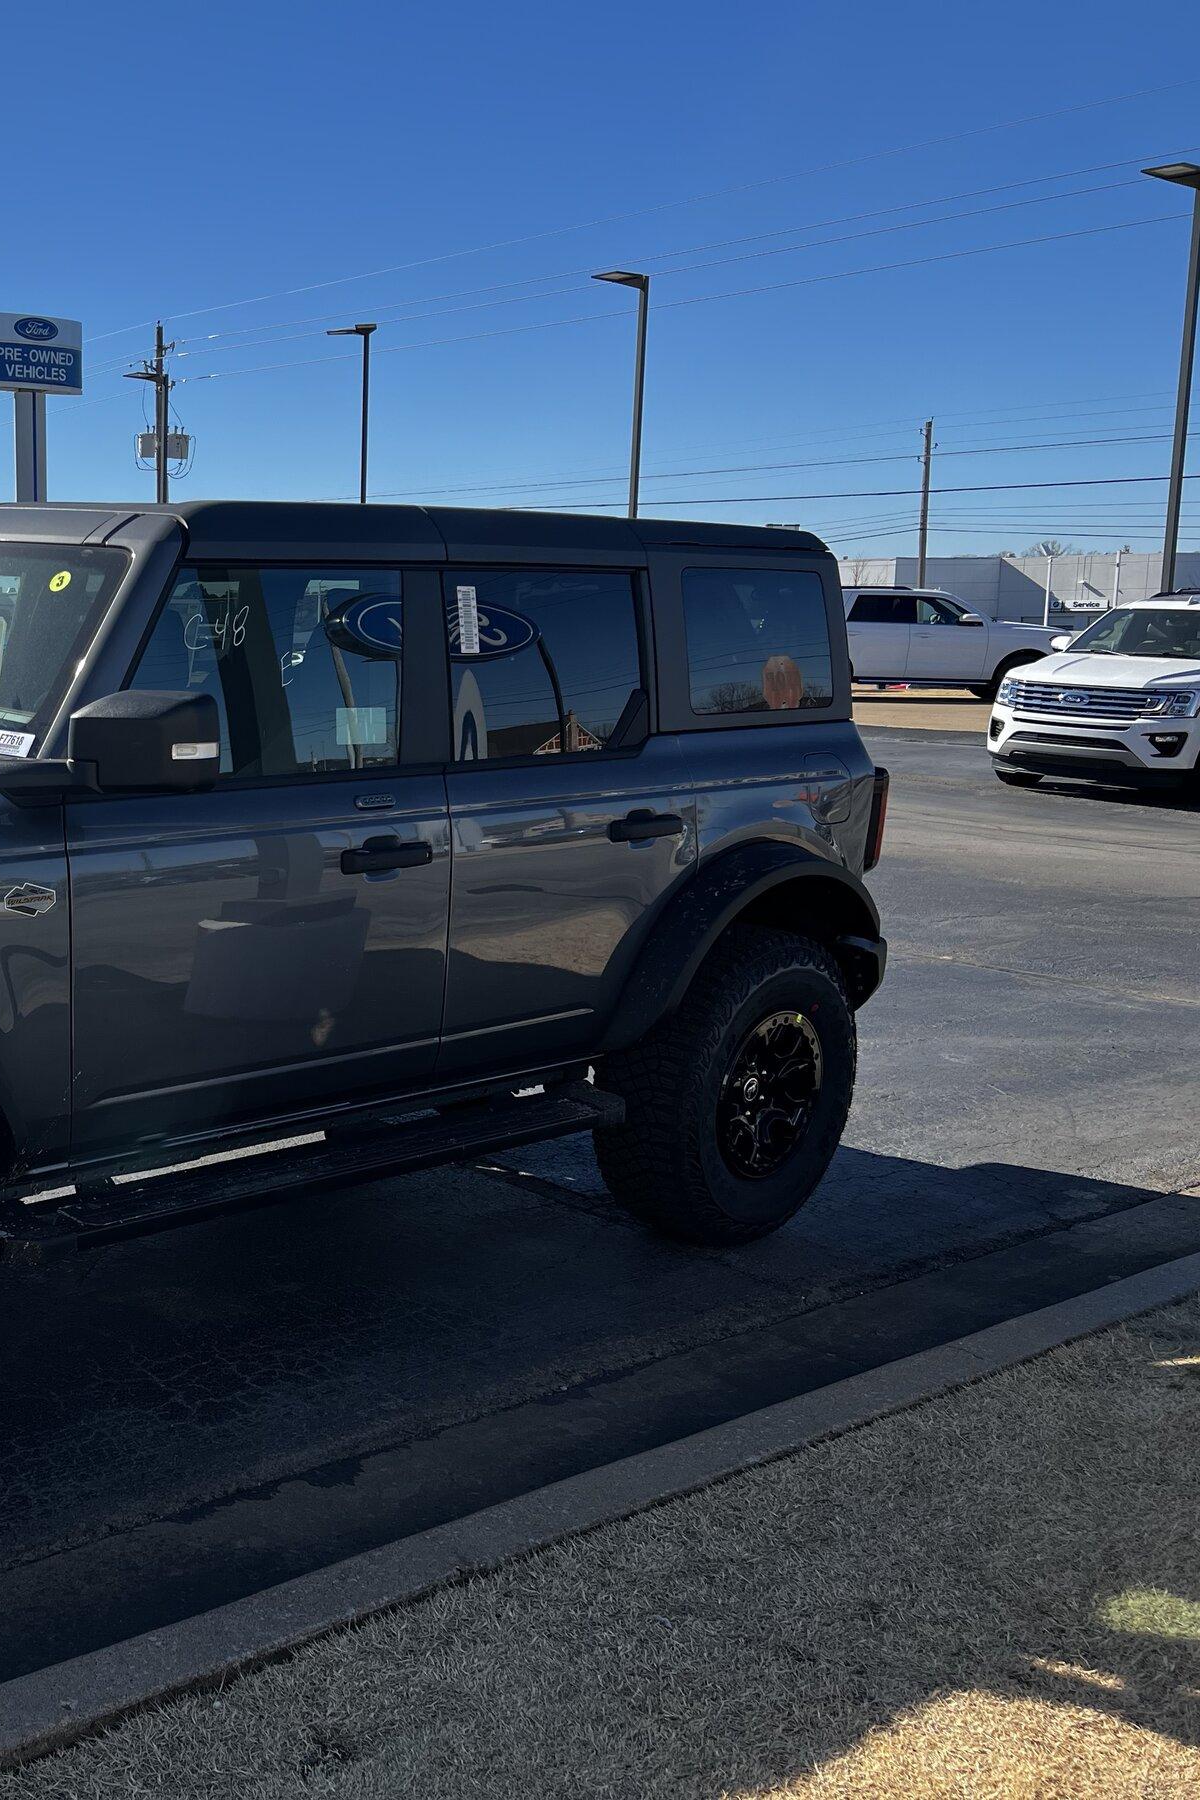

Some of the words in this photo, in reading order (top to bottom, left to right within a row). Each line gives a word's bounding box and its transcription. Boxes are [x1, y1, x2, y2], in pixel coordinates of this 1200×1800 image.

[25, 321, 50, 336] Ford
[5, 363, 67, 382] VEHICLES
[55, 575, 65, 588] 3
